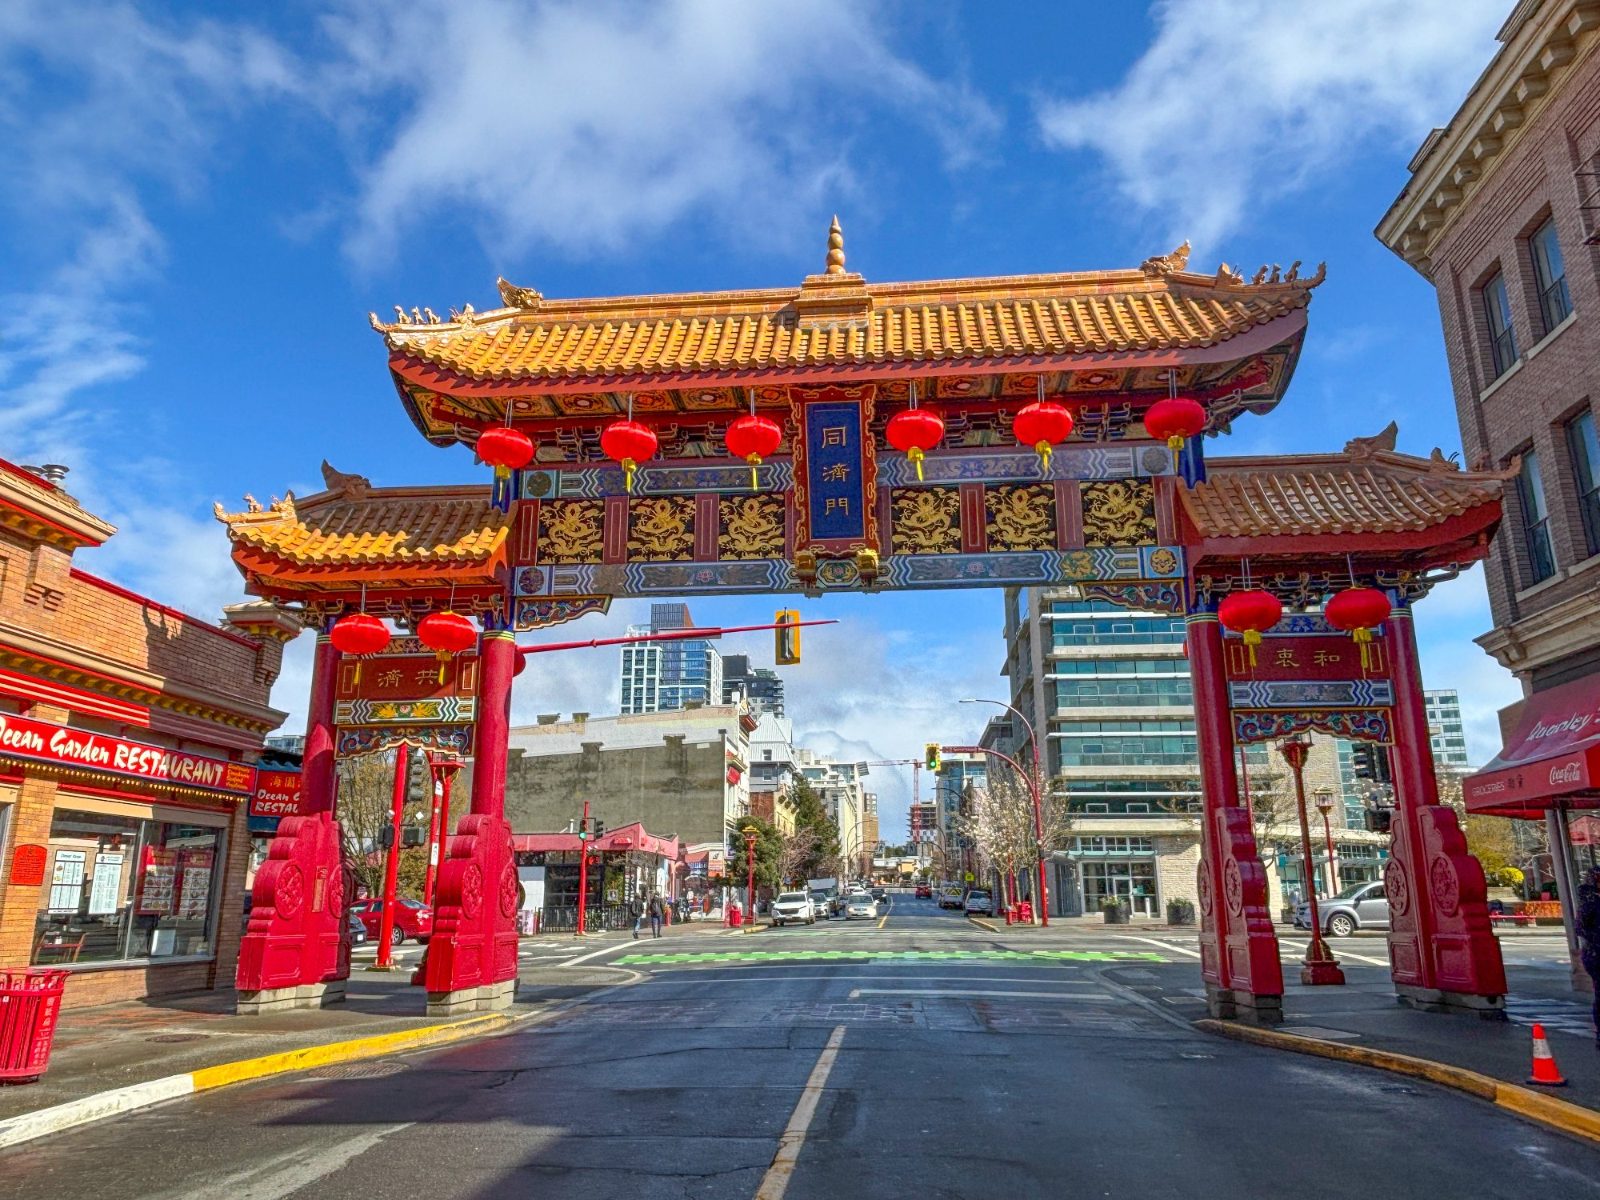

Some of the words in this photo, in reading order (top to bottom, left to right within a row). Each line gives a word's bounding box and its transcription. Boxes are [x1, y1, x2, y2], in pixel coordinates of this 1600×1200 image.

[821, 425, 850, 517] 同濟門
[50, 729, 109, 764] Garden
[114, 744, 223, 786] RESTAURANT
[257, 789, 289, 801] Ocean
